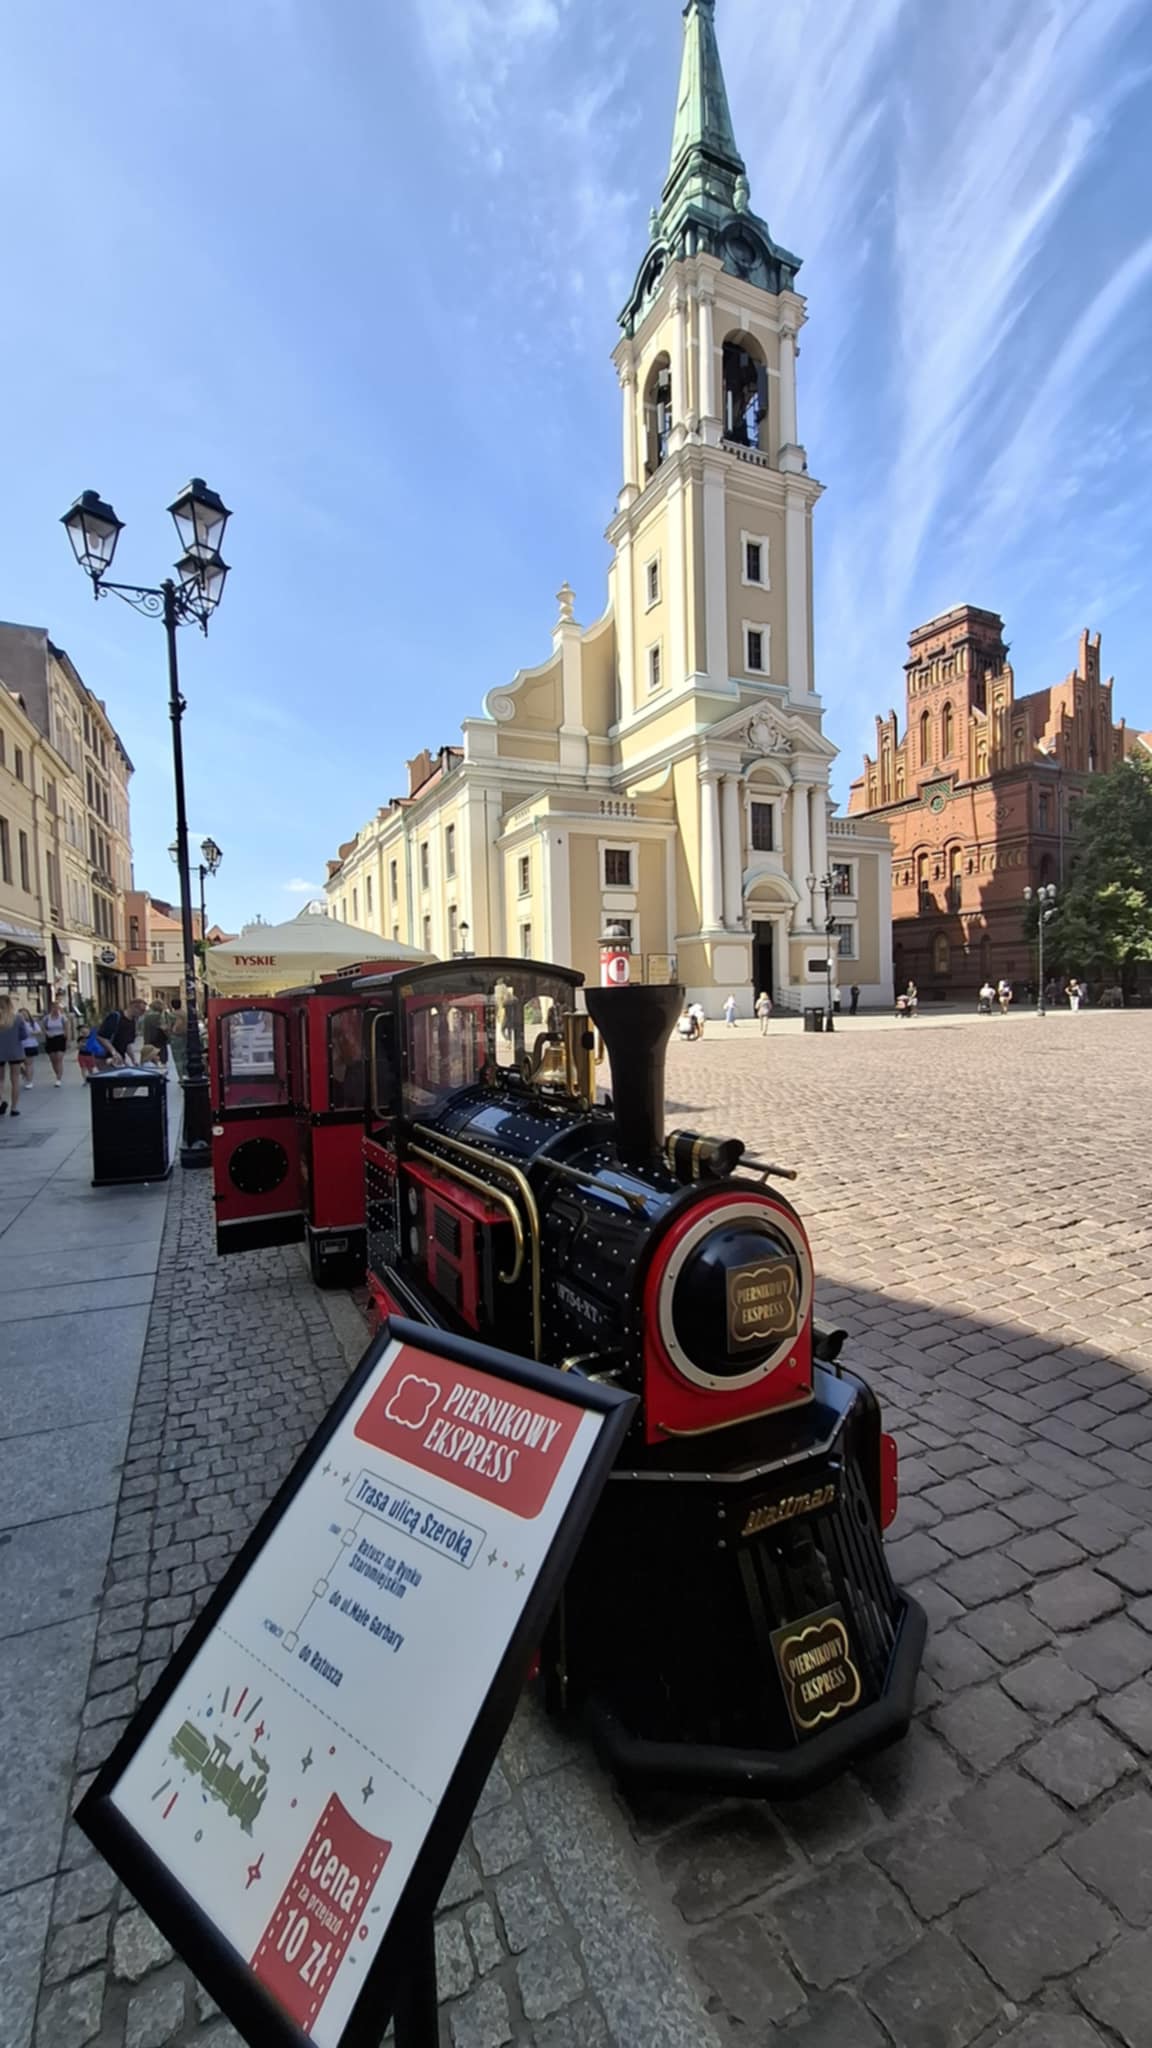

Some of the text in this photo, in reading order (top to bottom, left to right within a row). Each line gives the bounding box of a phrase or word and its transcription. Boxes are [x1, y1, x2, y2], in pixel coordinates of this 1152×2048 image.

[233, 955, 277, 966] TYSKIE
[736, 1279, 789, 1305] PIERNIKOWY
[742, 1303, 785, 1324] EKSPRESS
[442, 1383, 562, 1453] PIERNIKOWY
[422, 1417, 519, 1483] EKSPRESS
[355, 1478, 473, 1562] Trasa ulicą Szeroką
[358, 1538, 385, 1565] Ratusz
[384, 1556, 396, 1571] na
[329, 1590, 342, 1607] do
[369, 1615, 404, 1653] Garbary
[298, 1644, 343, 1688] do Ratusza
[789, 1637, 842, 1678] PIERNIKOWY
[800, 1665, 846, 1704] EKSPRESS
[298, 1884, 309, 1902] za
[310, 1838, 359, 1913] Cena
[277, 1908, 333, 1988] 10 zł
